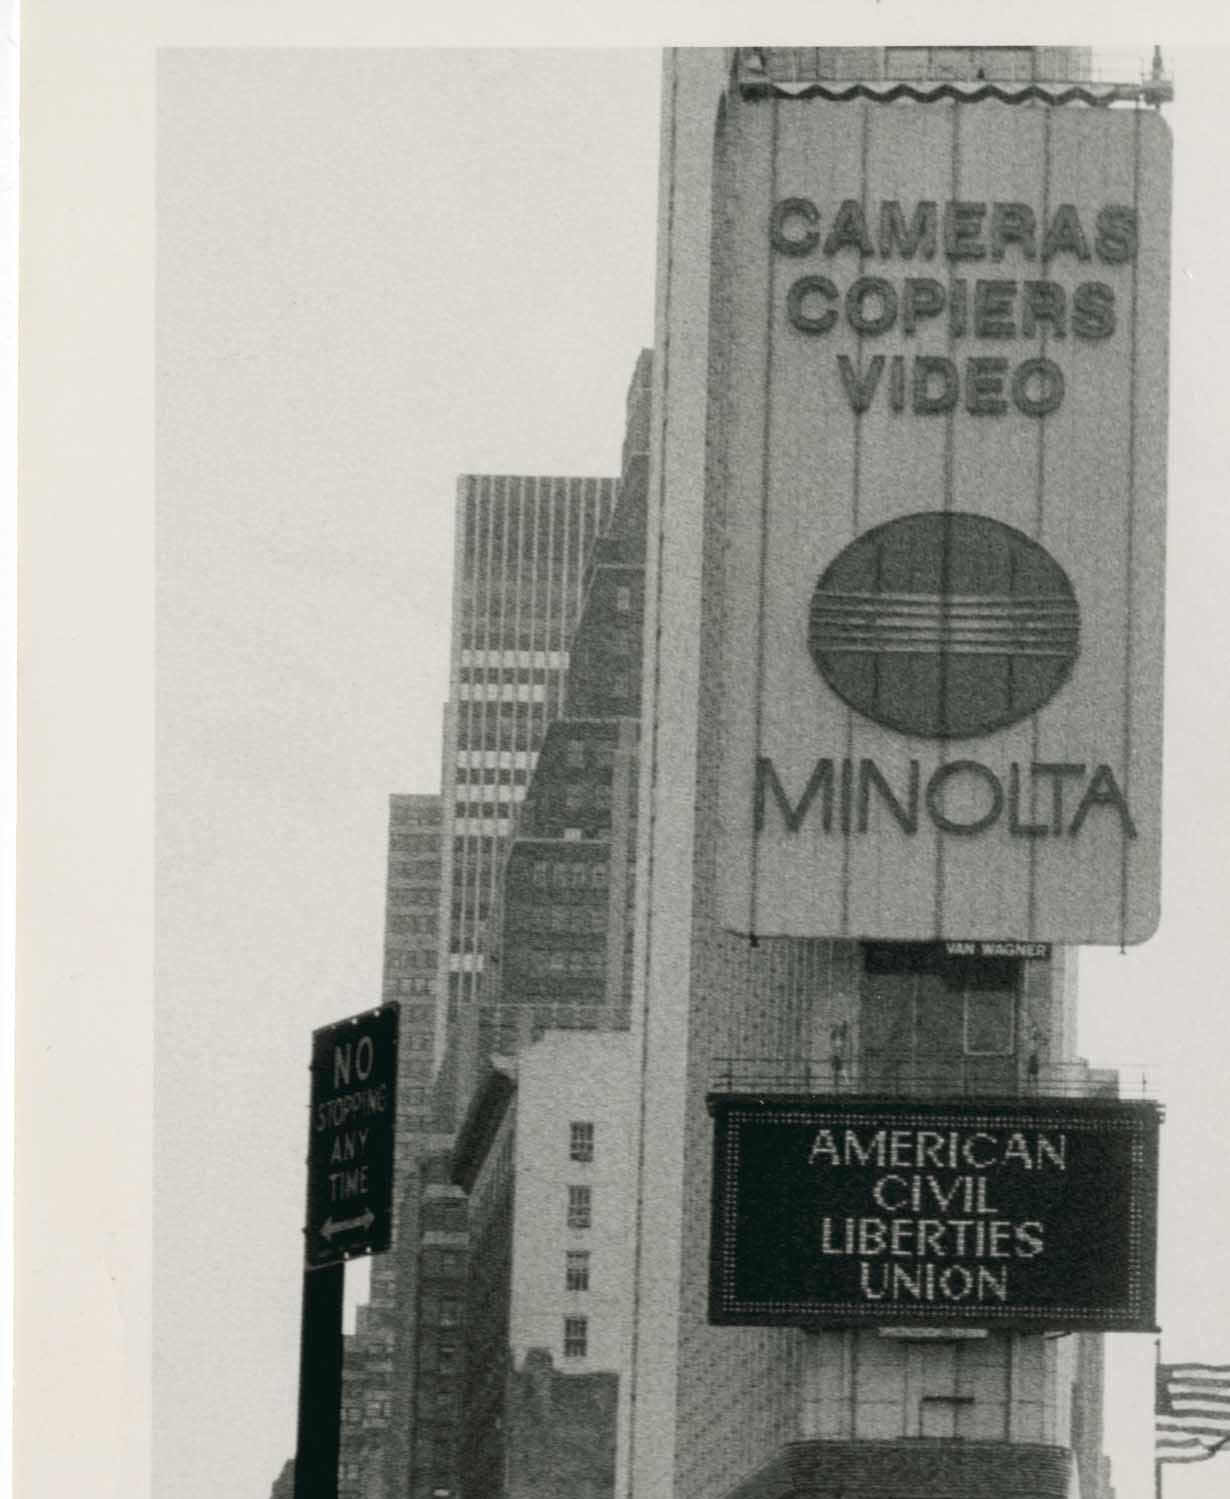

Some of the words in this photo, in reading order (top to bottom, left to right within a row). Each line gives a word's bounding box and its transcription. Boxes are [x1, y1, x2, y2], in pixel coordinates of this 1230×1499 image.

[769, 198, 1138, 264] CAMERAS
[785, 275, 1117, 339] COPIERS
[836, 355, 1066, 416] VIDEO
[753, 757, 1138, 840] MINOLTA
[945, 942, 977, 957] VAN
[981, 943, 1048, 959] WAGNER
[333, 1036, 374, 1088] NO
[316, 1083, 388, 1132] STOPPING
[330, 1127, 369, 1165] ANY
[808, 1129, 1068, 1171] AMERICAN
[327, 1166, 370, 1202] TIME
[873, 1175, 999, 1213] CIVIL
[822, 1217, 1045, 1258] LIBERTIES
[859, 1262, 1008, 1301] UNION
